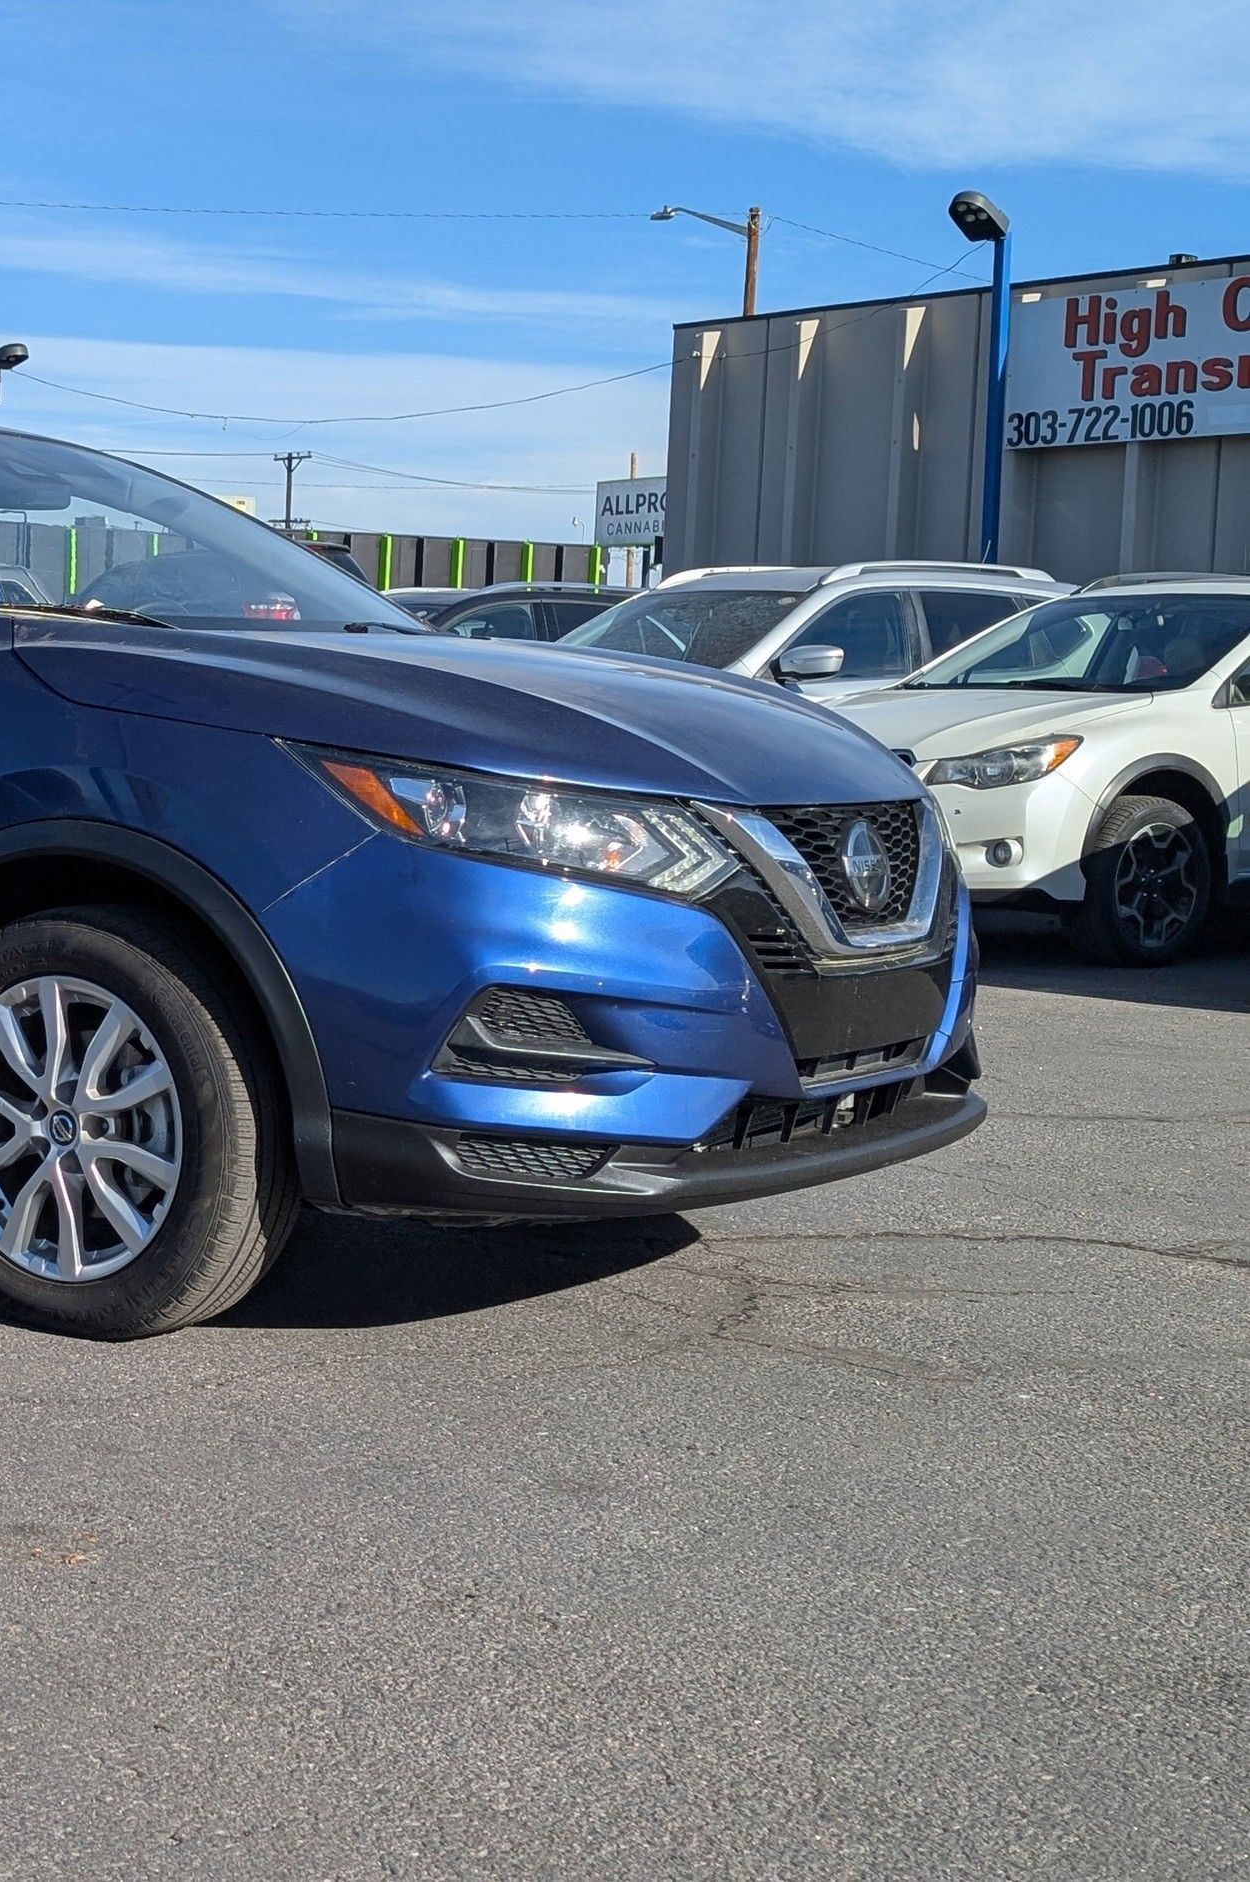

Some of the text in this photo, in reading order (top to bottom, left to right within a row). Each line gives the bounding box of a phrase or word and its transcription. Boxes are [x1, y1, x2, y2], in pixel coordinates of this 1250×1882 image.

[1064, 290, 1187, 358] High
[1072, 350, 1250, 402] Trans
[1006, 400, 1195, 448] 303-722-1006
